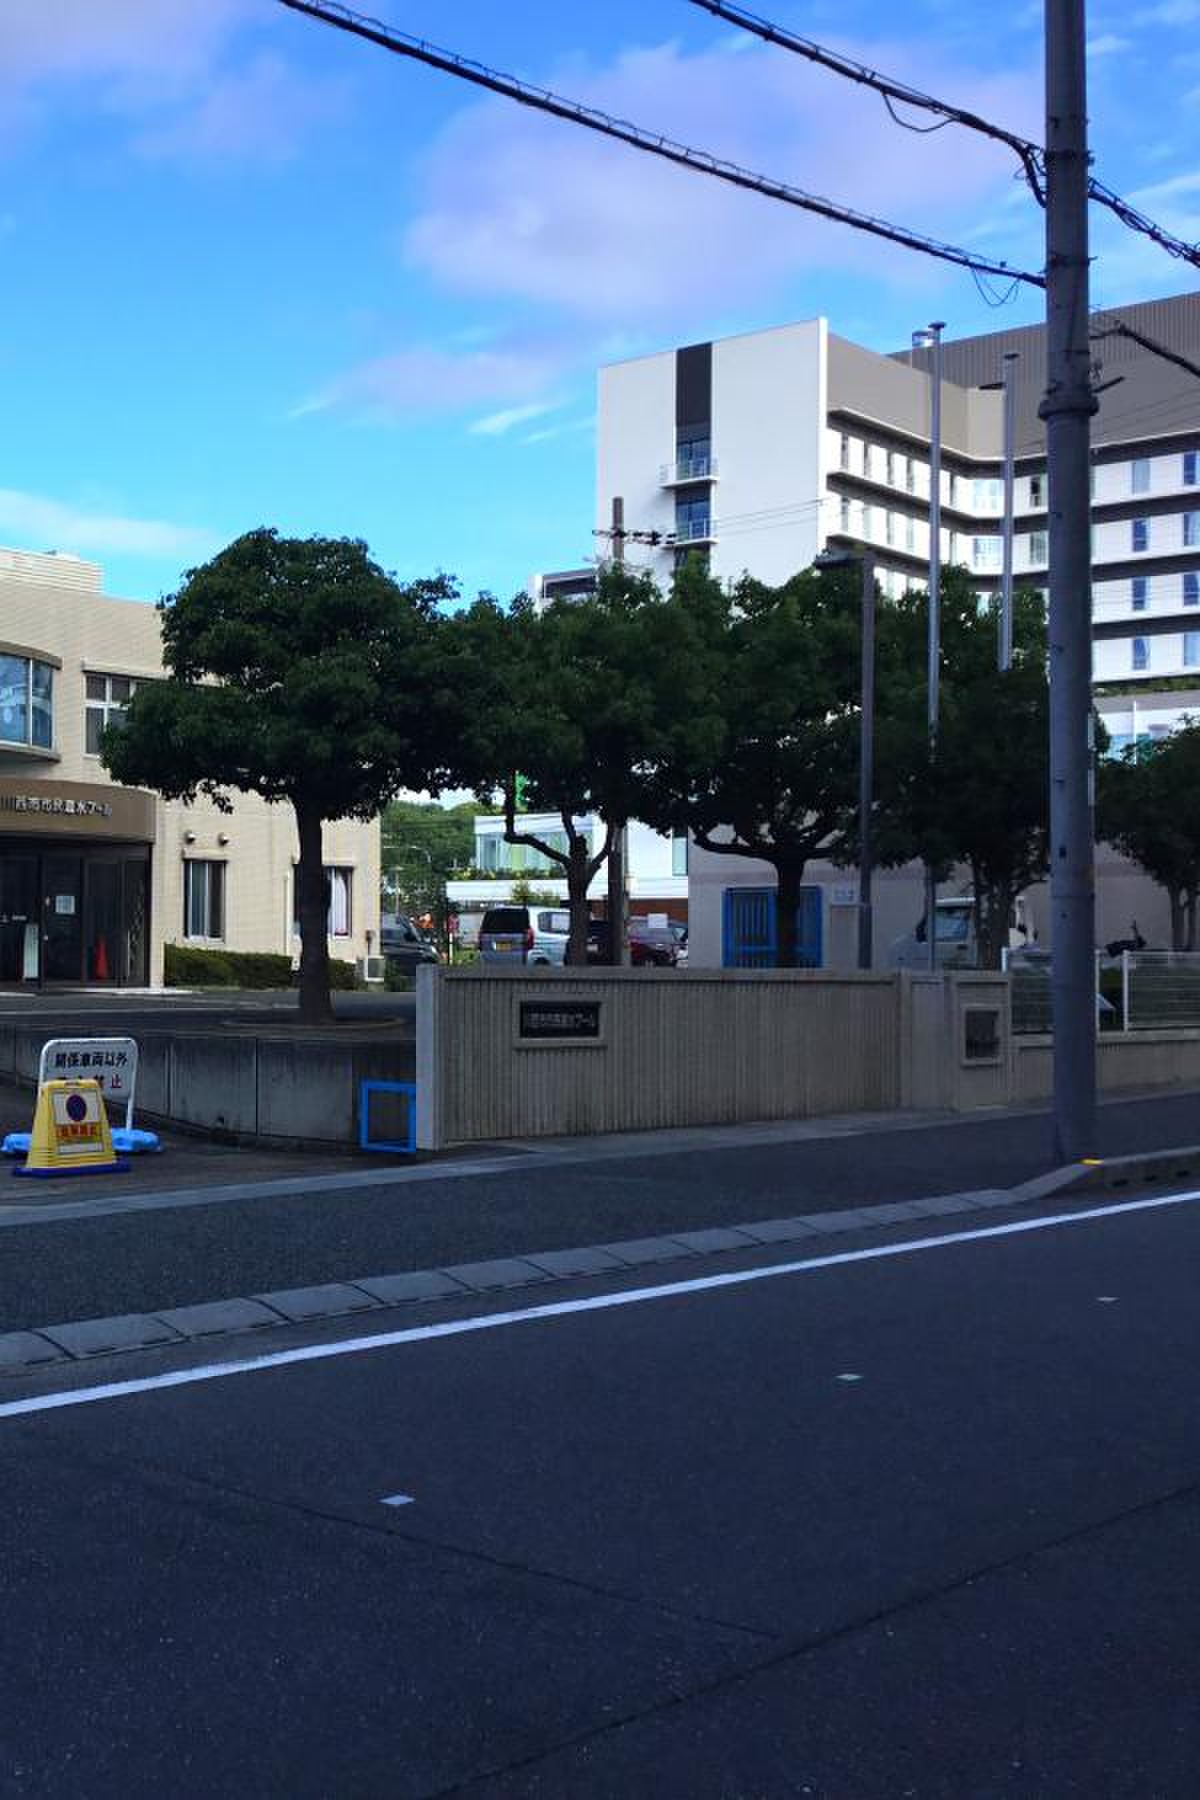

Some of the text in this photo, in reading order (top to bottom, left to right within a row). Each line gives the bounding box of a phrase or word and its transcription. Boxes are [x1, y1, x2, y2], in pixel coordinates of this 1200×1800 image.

[55, 1052, 128, 1067] 関係車両以外
